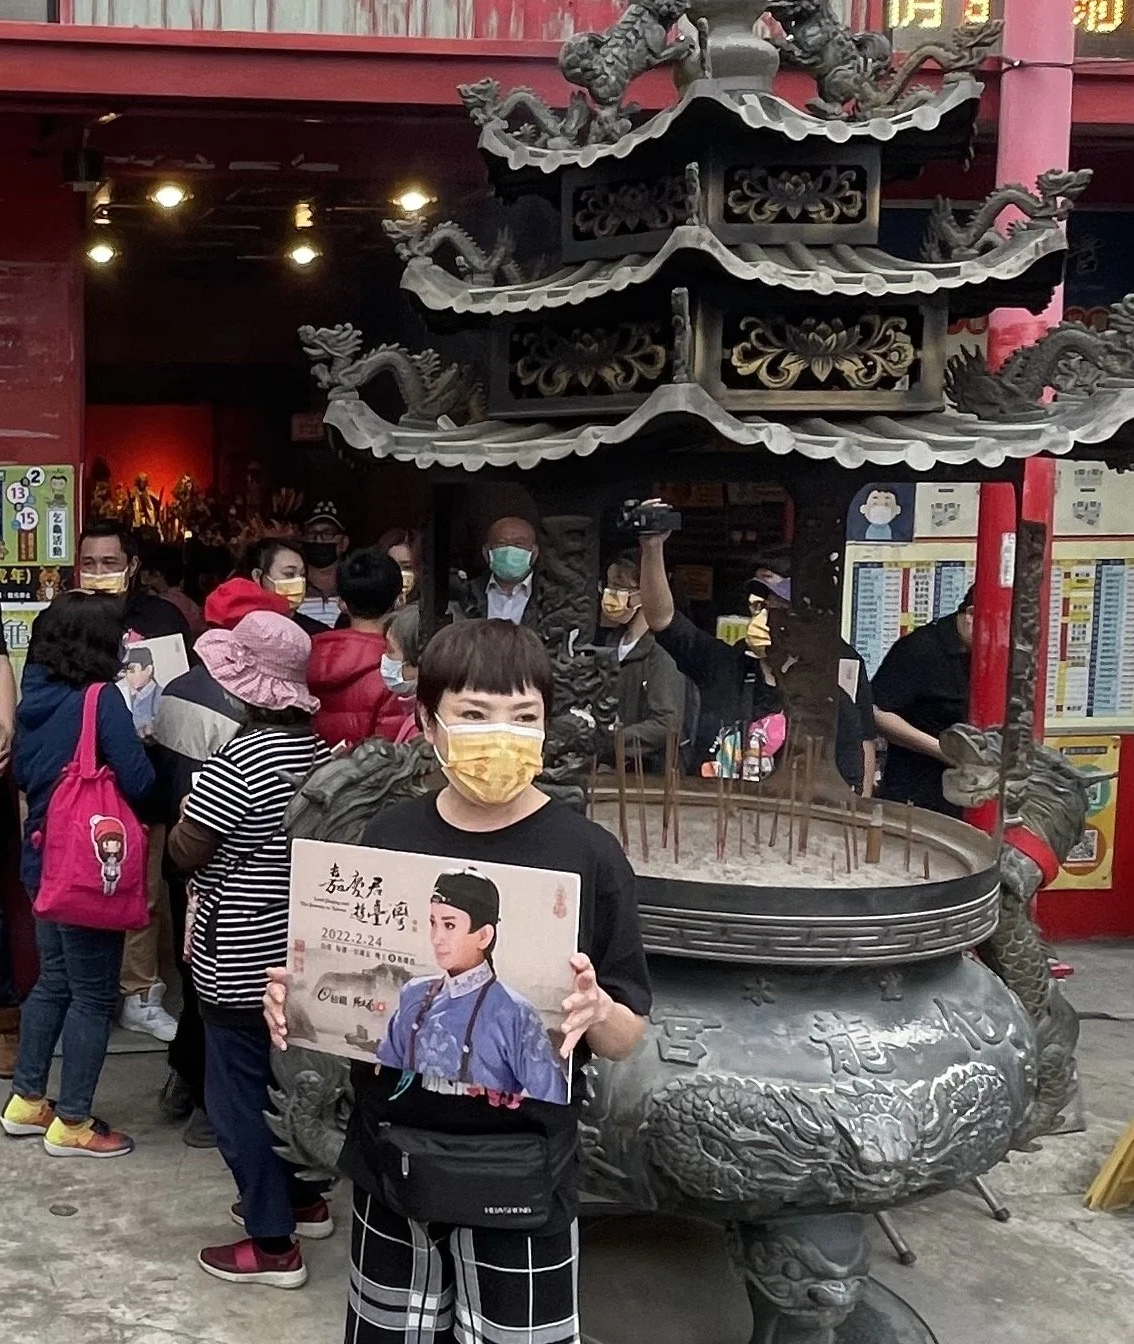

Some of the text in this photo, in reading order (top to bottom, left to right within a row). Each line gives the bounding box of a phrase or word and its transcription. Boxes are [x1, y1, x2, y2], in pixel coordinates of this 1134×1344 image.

[30, 469, 41, 484] 2
[10, 487, 25, 500] 13
[20, 512, 35, 525] 15
[321, 927, 383, 947] 2022.2.24
